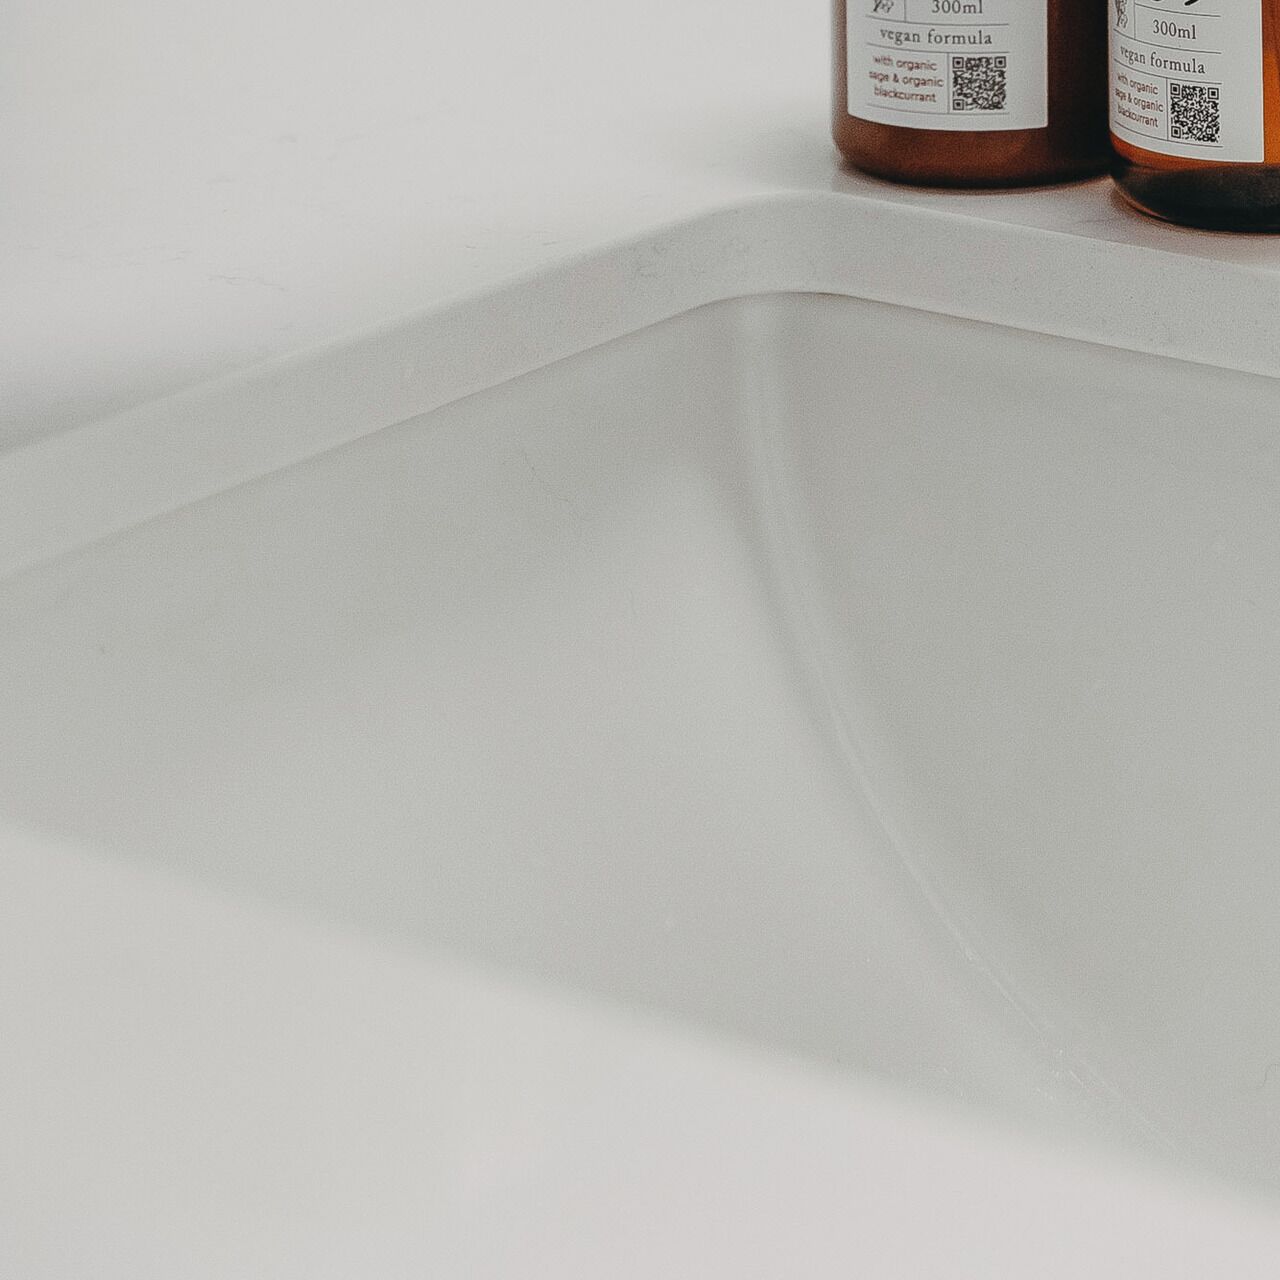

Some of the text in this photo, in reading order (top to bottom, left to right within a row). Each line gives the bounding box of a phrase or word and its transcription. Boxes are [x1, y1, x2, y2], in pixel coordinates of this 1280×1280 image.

[931, 0, 984, 15] 300ml
[879, 28, 993, 46] vegan formula
[1152, 19, 1197, 40] 300ml
[874, 55, 937, 72] with organic
[1119, 45, 1206, 74] vegan formula
[893, 72, 900, 84] &
[902, 73, 944, 89] organic
[1117, 73, 1159, 96] with organic
[873, 86, 937, 103] blackcurrant
[1133, 94, 1164, 113] organic
[1117, 104, 1159, 128] blackcurrant
